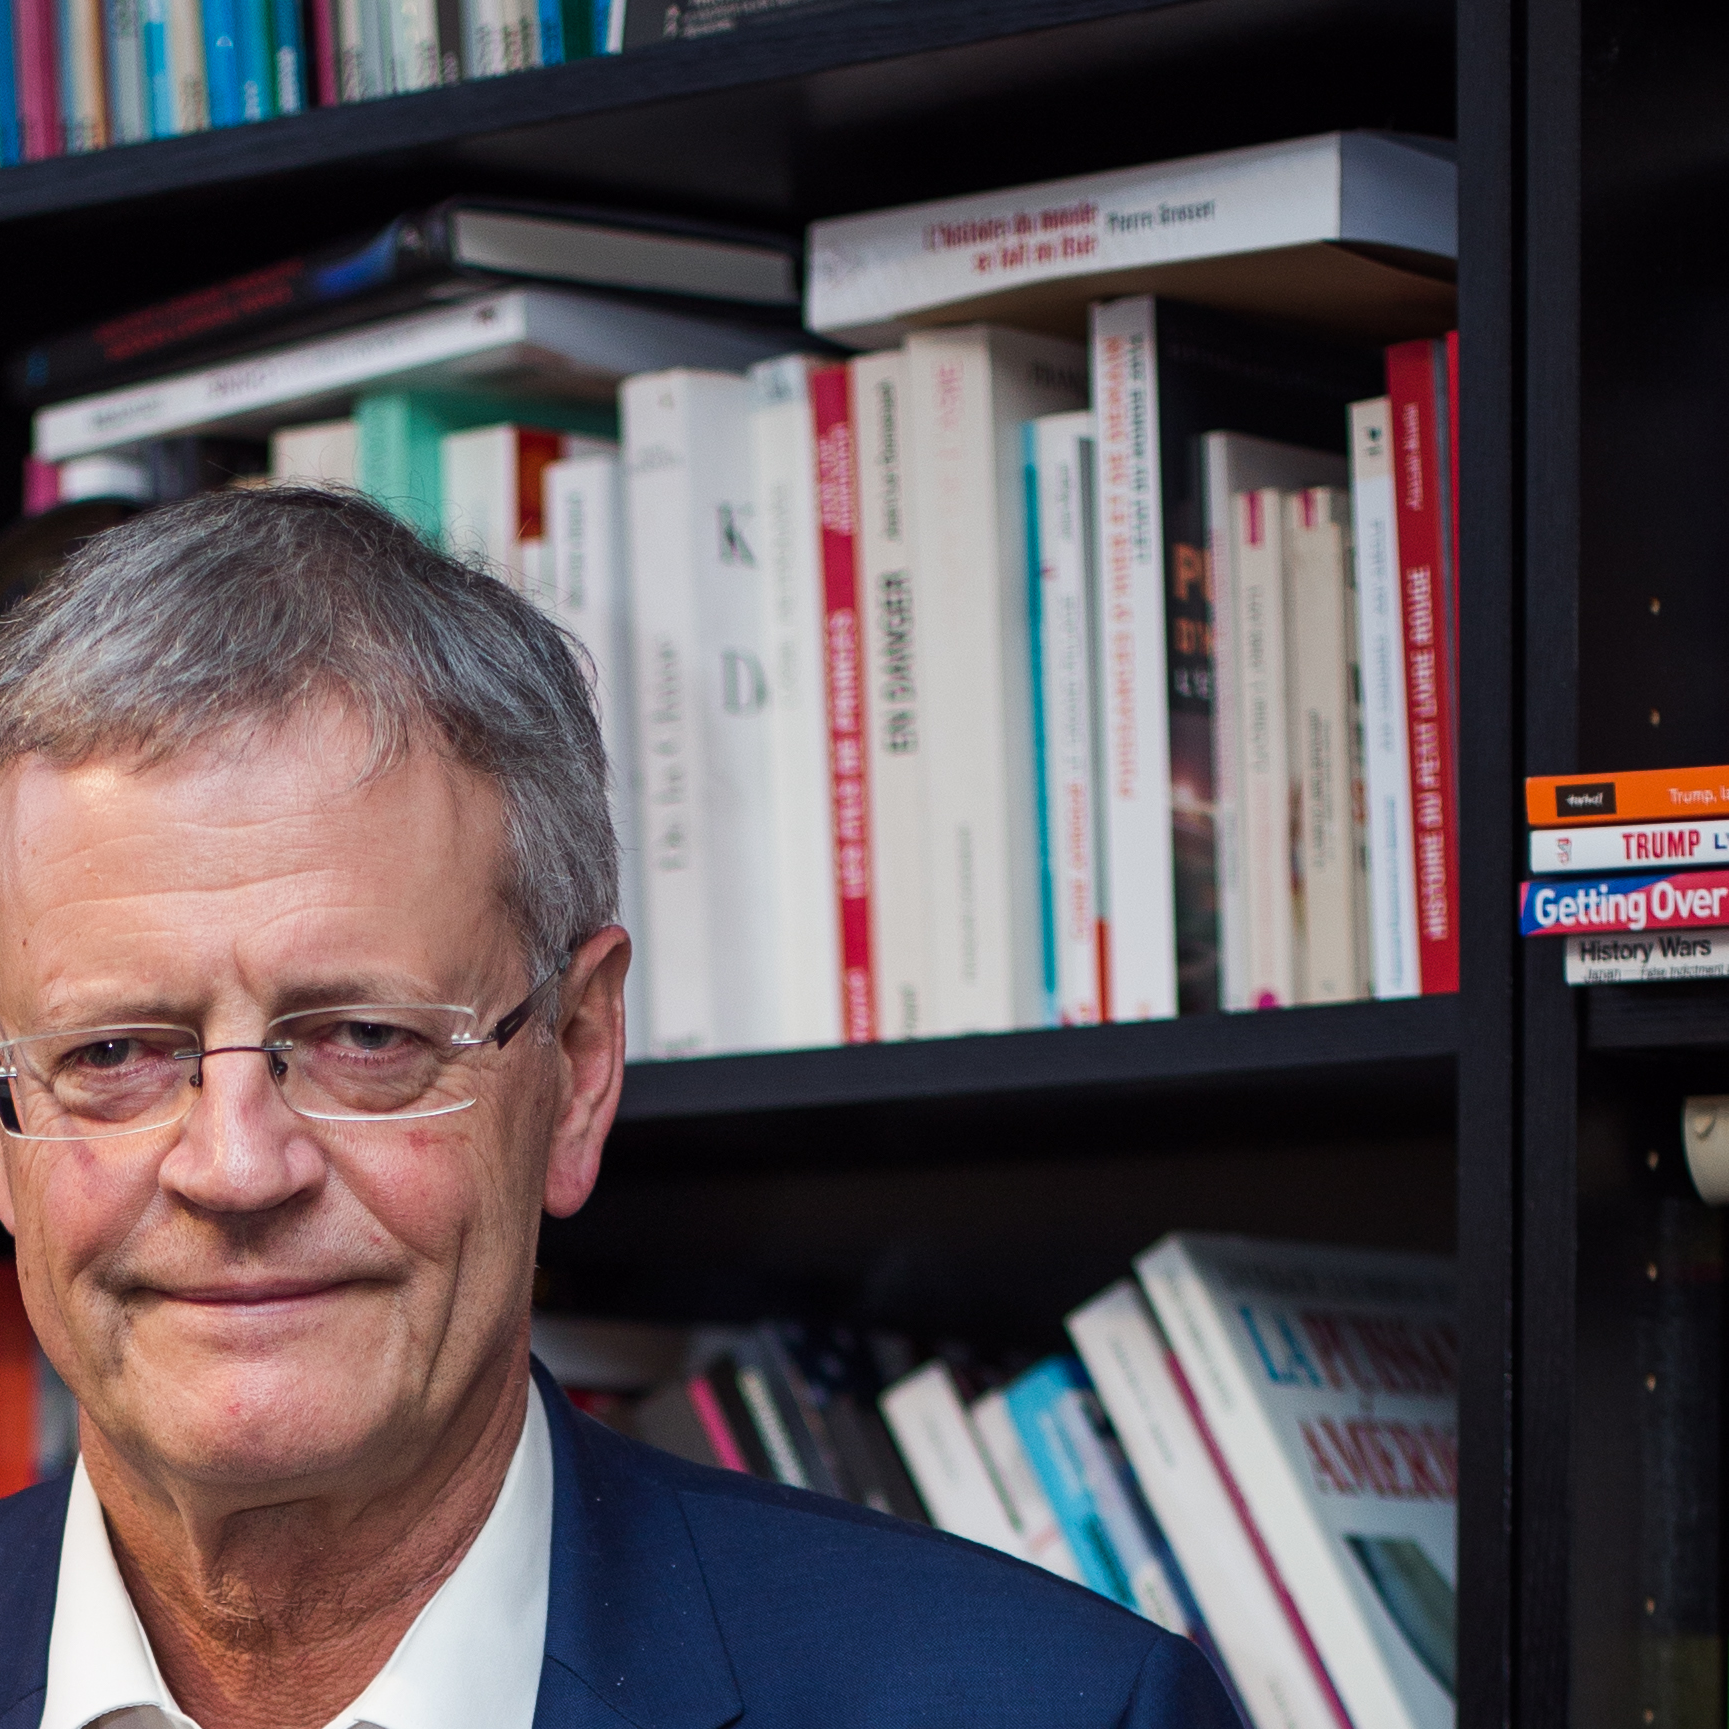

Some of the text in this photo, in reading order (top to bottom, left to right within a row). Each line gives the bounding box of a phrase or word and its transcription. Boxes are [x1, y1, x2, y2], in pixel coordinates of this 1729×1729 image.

[1406, 564, 1449, 941] HISTOIRE DU PETIT LIVRE ROUGE
[1668, 787, 1718, 806] Trump,
[1622, 829, 1702, 862] TRUMP
[1534, 880, 1729, 932] Getting Over
[1580, 934, 1713, 963] History Wars
